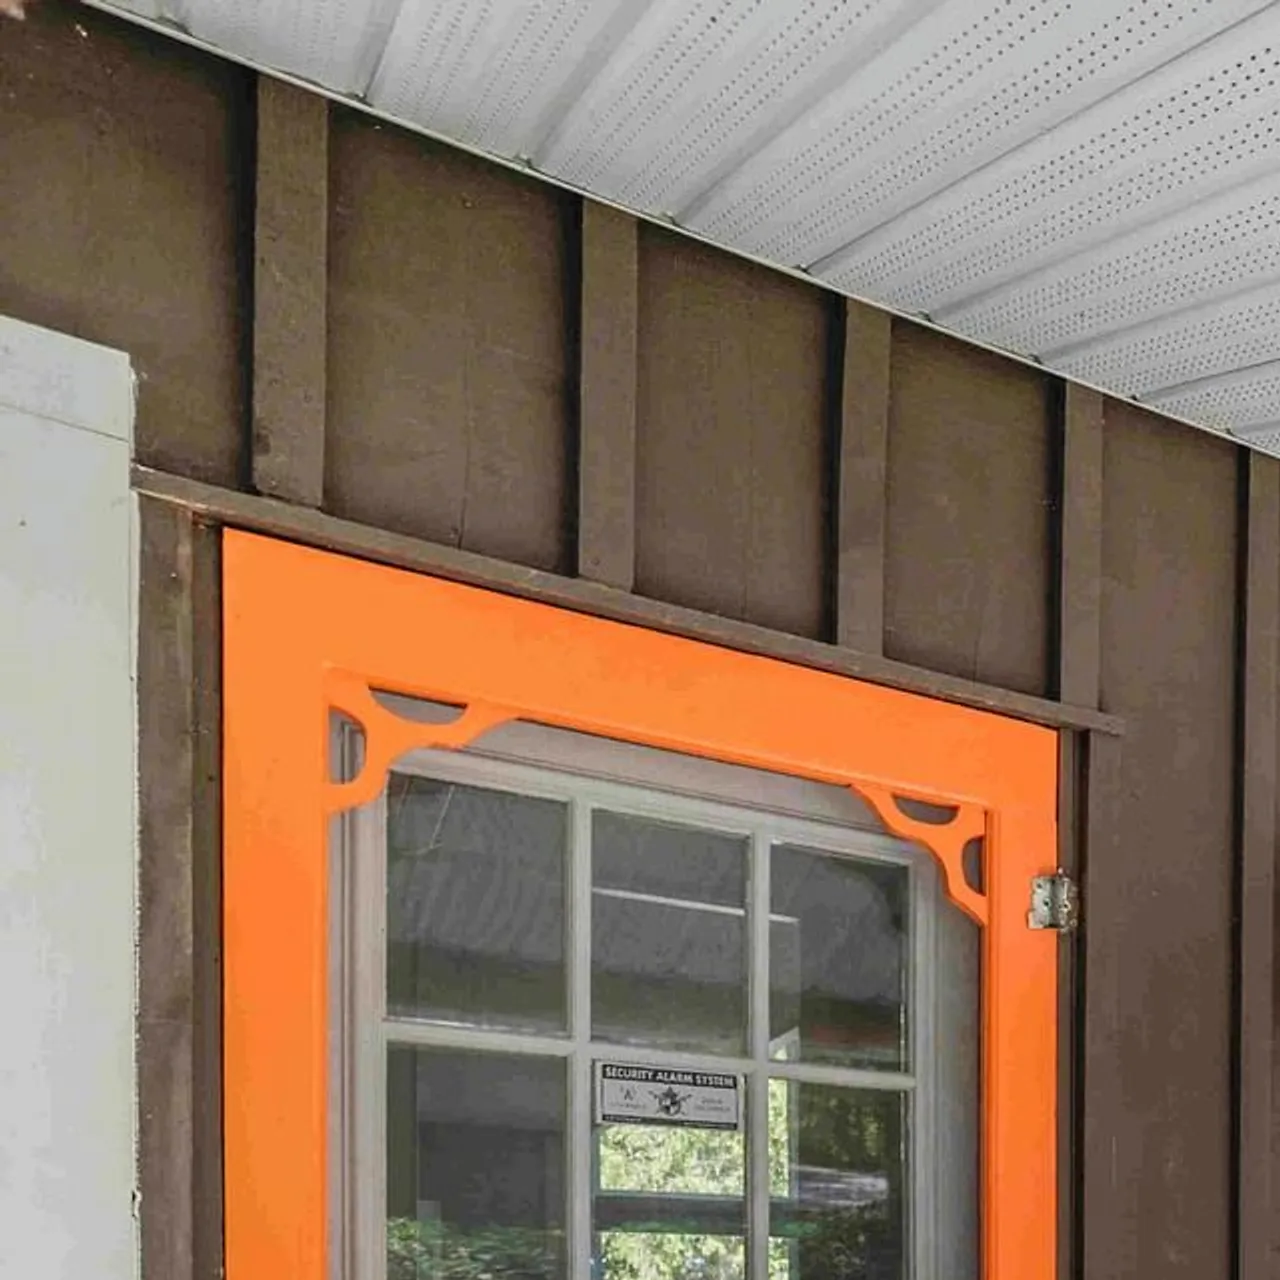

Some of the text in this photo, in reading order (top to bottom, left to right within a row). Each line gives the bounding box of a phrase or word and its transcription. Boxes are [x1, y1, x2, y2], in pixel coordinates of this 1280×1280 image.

[605, 1066, 735, 1088] SECURITY ALARM SYSTEM
